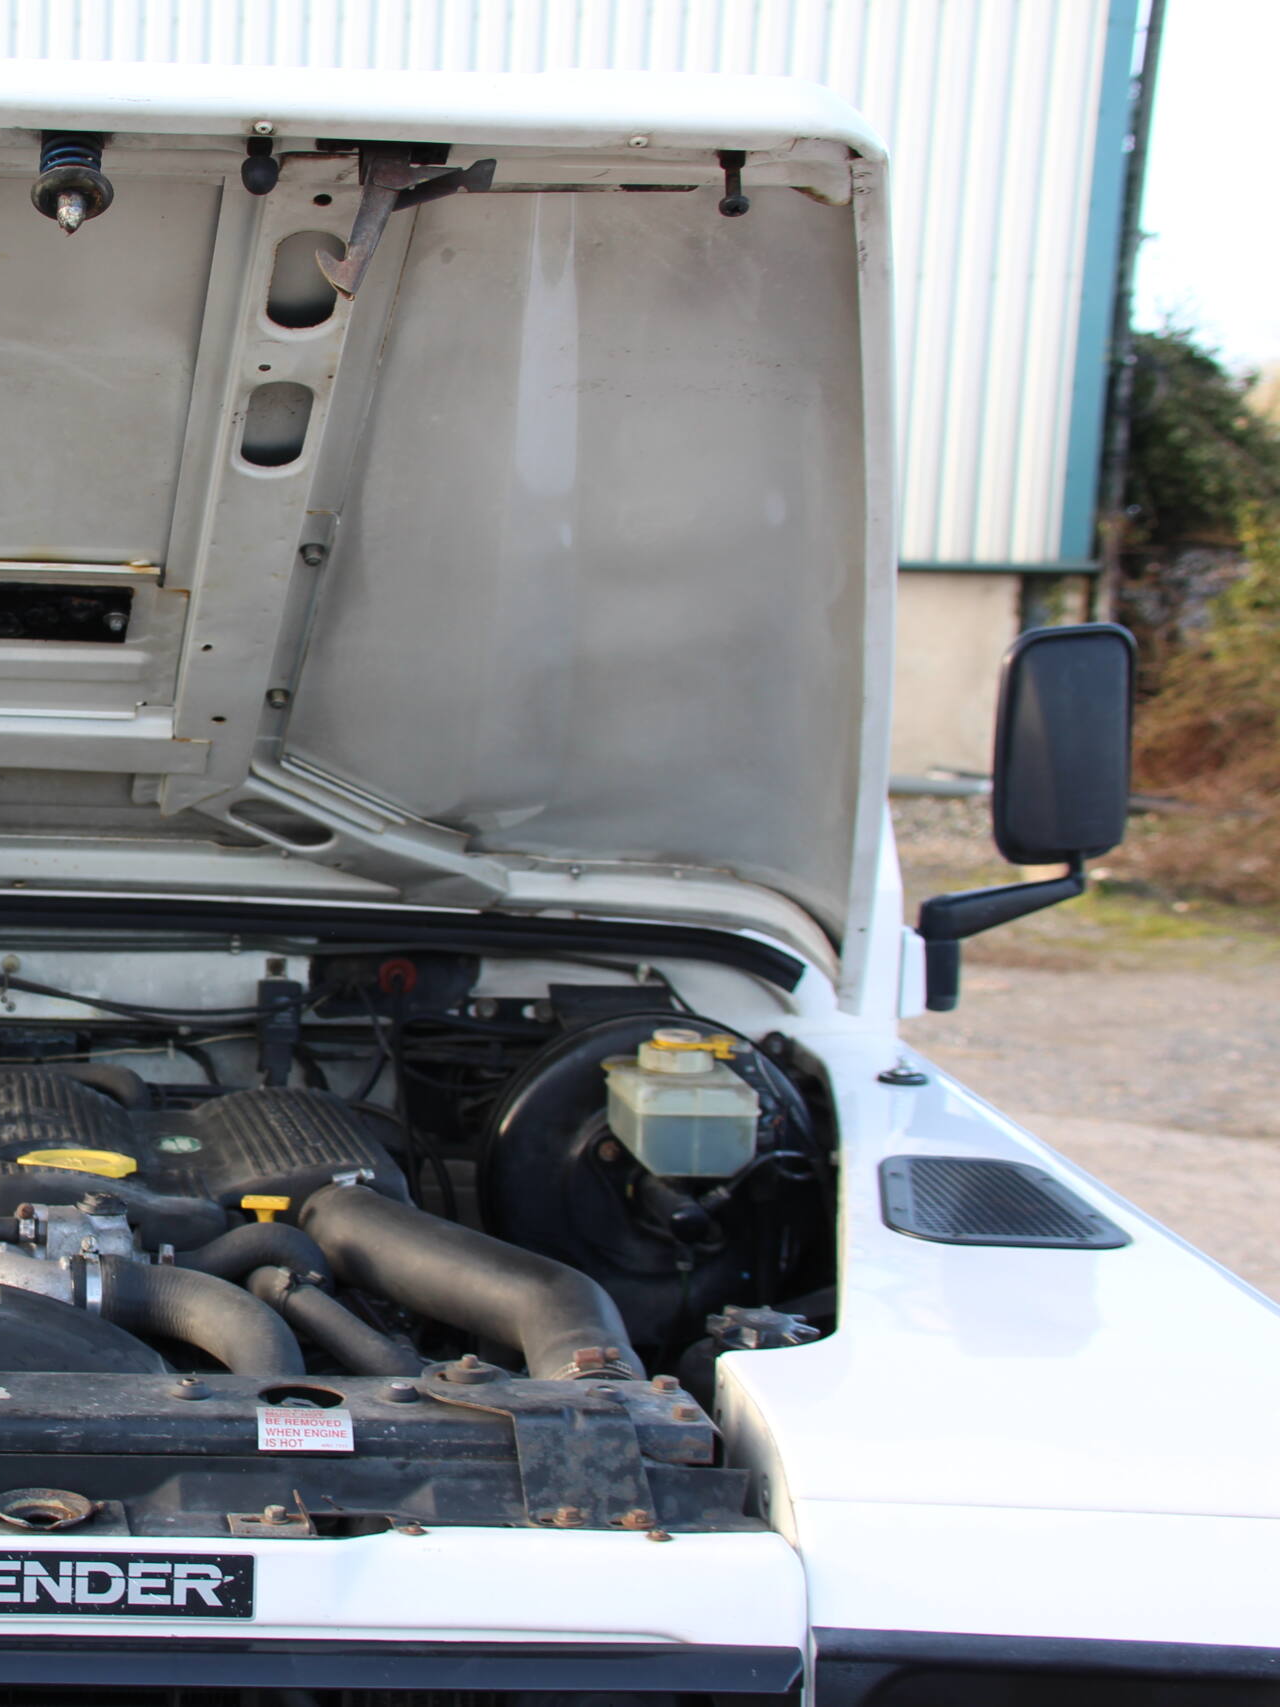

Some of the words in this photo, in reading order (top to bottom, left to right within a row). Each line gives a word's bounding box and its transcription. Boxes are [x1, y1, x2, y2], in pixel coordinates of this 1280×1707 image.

[264, 1417, 281, 1426] BE
[284, 1418, 342, 1428] REMOVED
[265, 1427, 301, 1438] WHEN
[303, 1429, 349, 1439] ENGINE
[265, 1438, 277, 1448] IS
[280, 1438, 305, 1449] HOT
